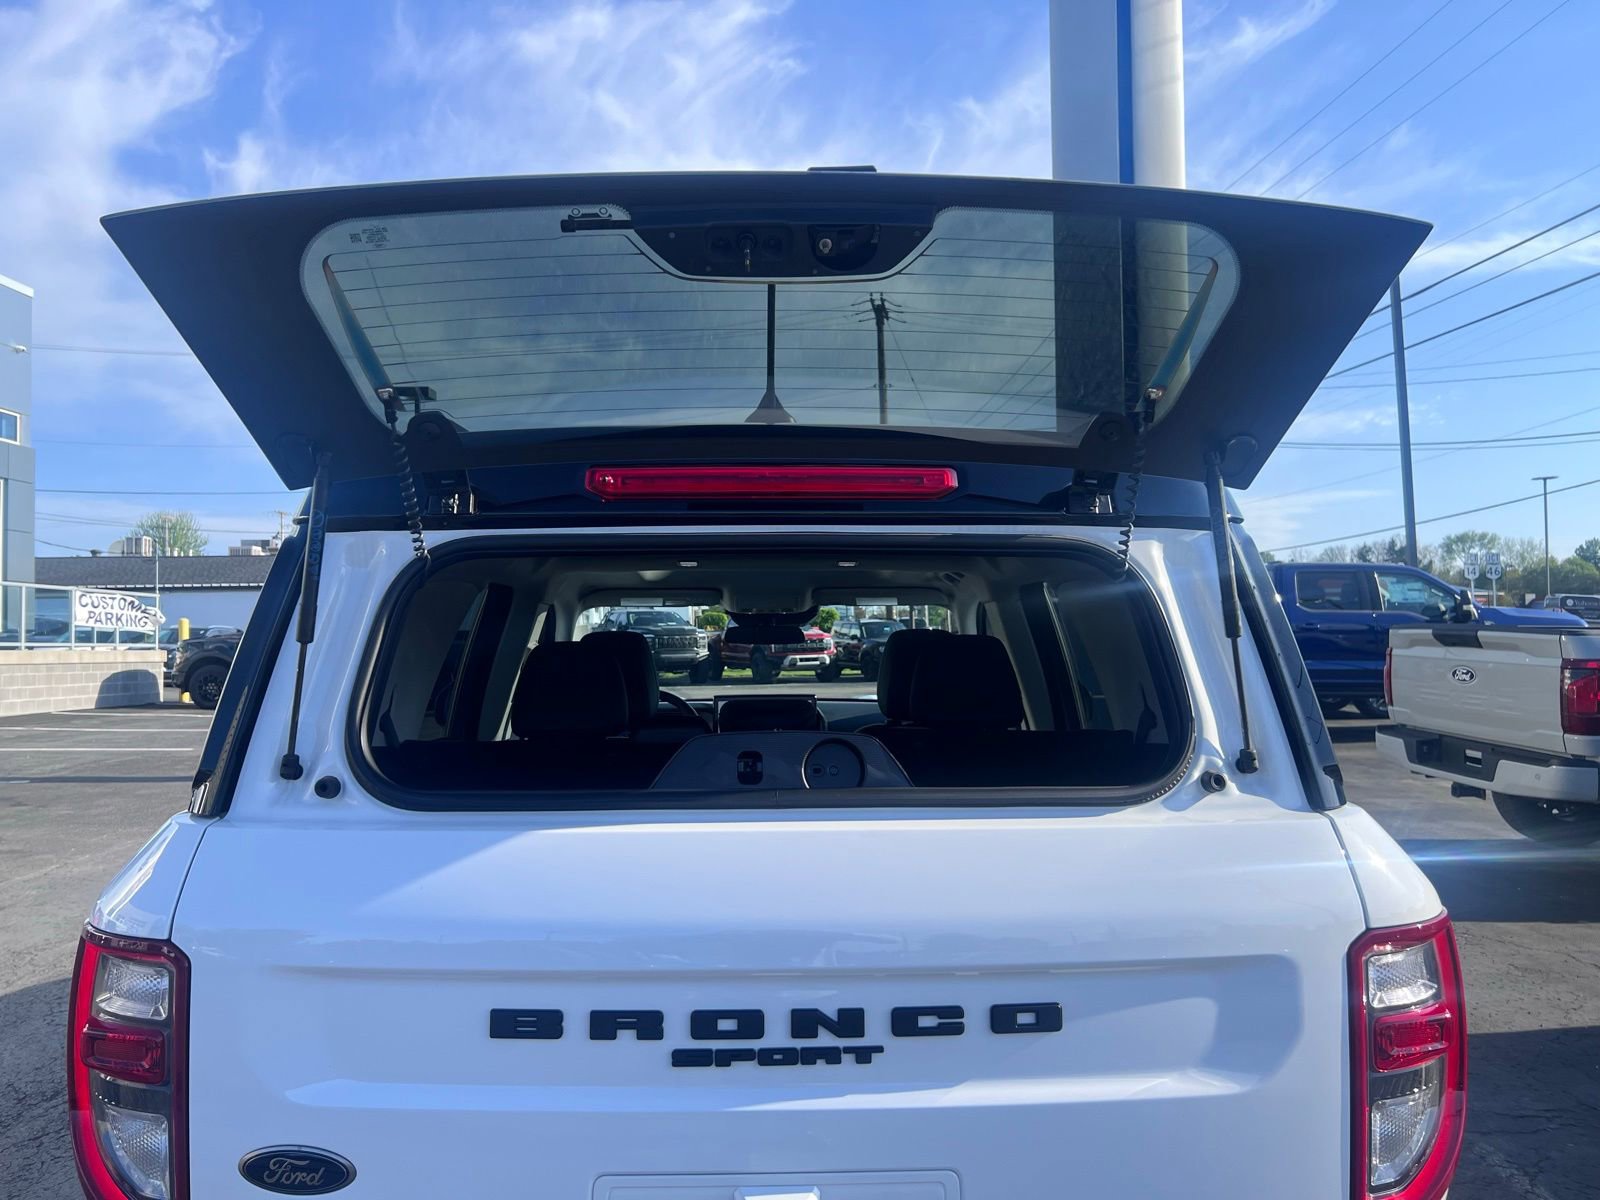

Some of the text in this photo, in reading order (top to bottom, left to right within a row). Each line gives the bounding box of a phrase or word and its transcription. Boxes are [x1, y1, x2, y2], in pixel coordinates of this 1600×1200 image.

[1466, 567, 1477, 576] 14
[1487, 567, 1500, 576] 46
[86, 611, 149, 628] PARKING
[490, 1002, 1062, 1040] BRONCO
[671, 1045, 884, 1067] SPORT
[263, 1158, 326, 1186] Ford
